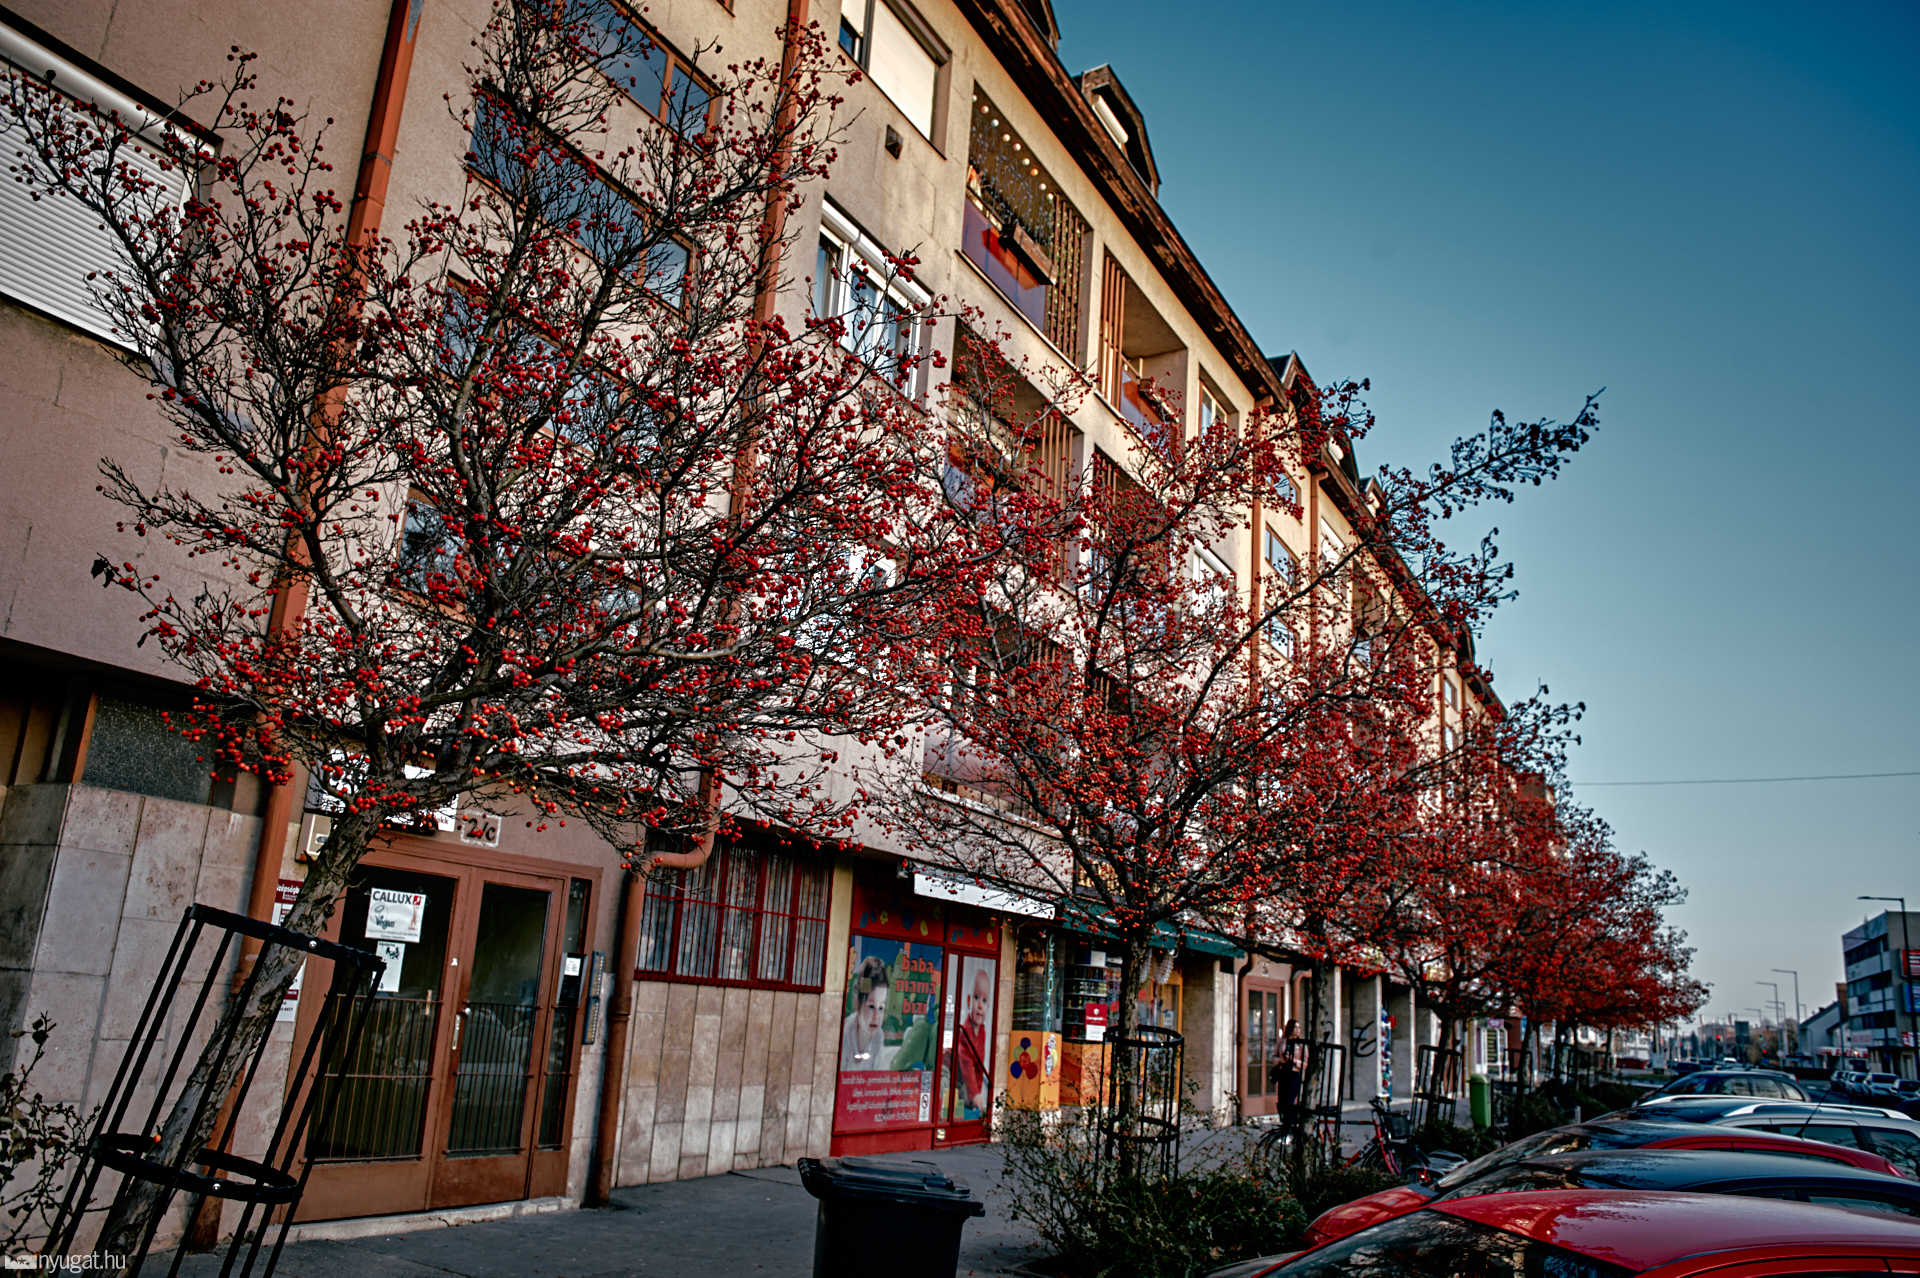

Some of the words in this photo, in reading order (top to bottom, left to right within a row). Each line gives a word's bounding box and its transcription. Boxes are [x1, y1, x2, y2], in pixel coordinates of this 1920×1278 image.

[372, 890, 413, 905] CALLUX
[902, 954, 935, 975] baba
[895, 979, 937, 995] mama
